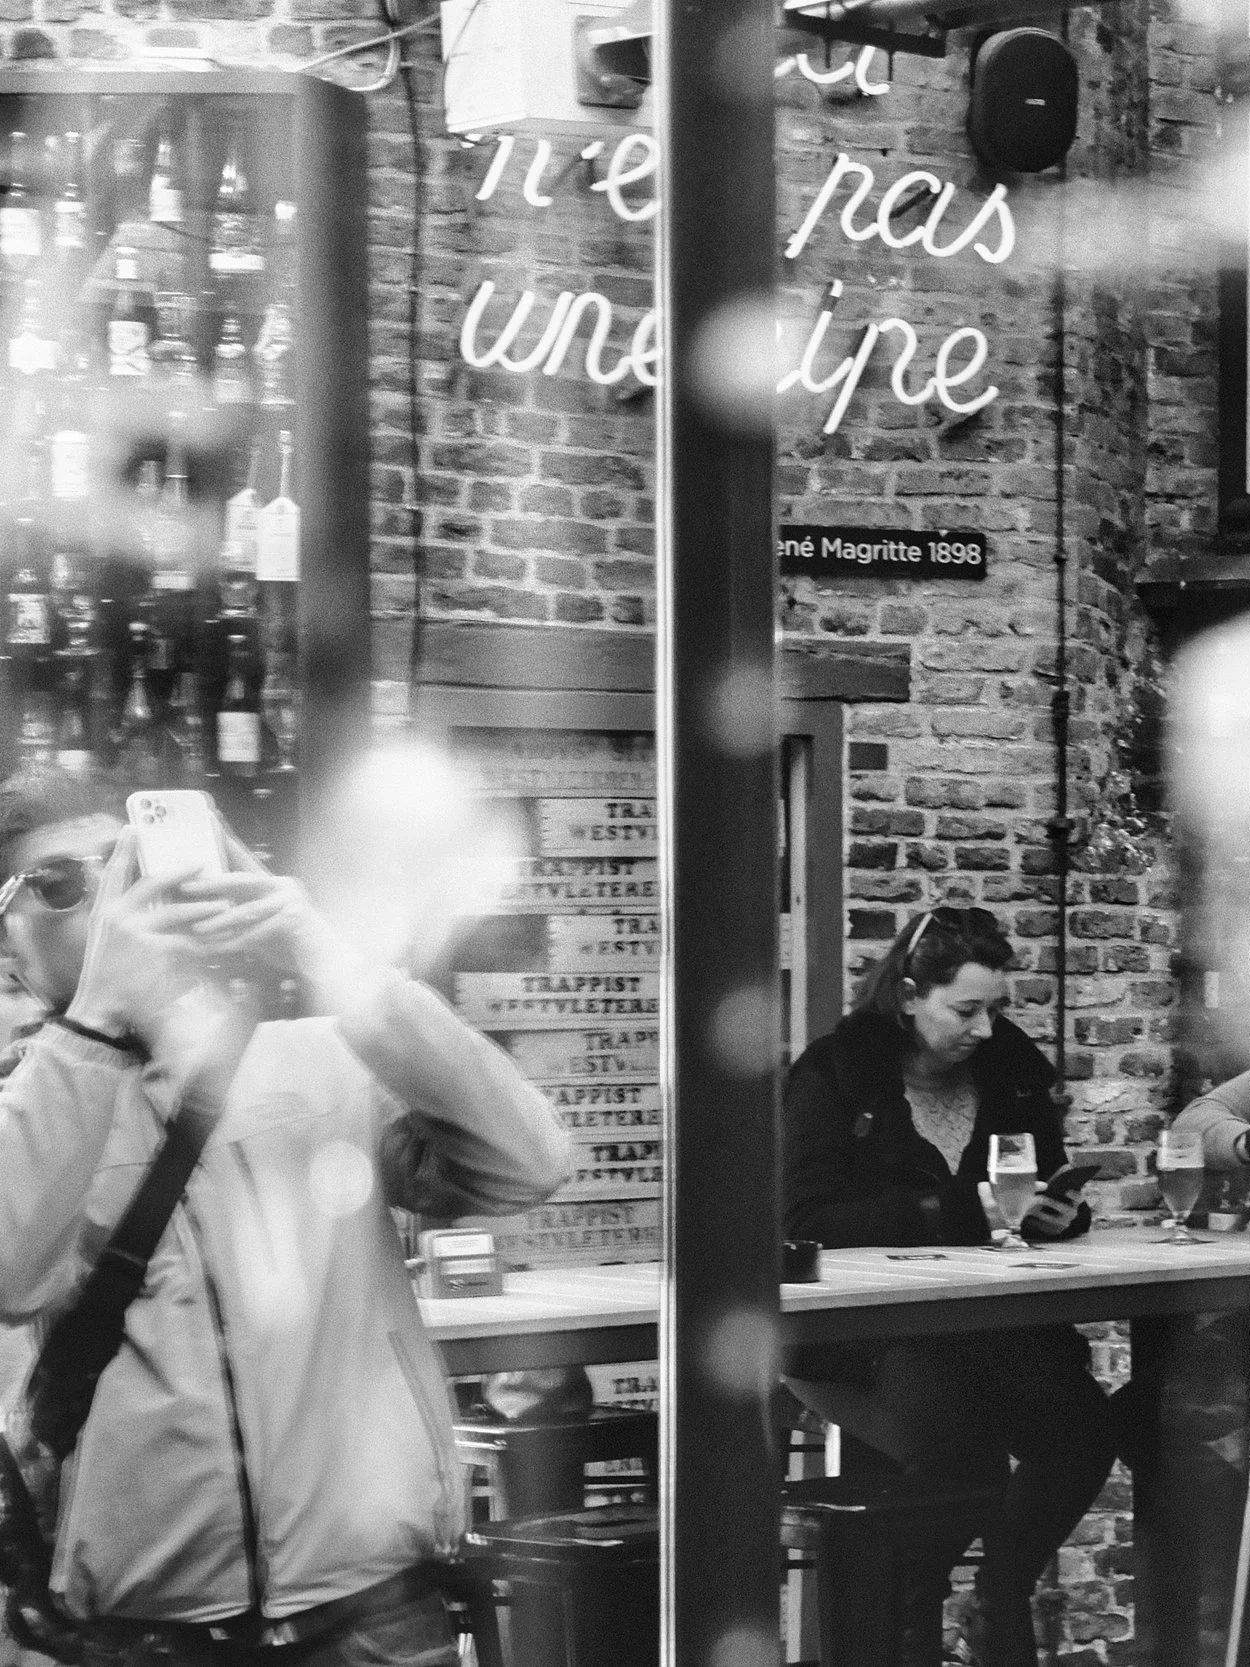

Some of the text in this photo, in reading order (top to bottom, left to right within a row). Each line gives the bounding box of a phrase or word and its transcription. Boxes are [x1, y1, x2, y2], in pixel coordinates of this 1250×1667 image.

[785, 153, 1016, 263] pas
[775, 279, 999, 434] ipe
[821, 537, 922, 564] Magritte
[928, 541, 982, 565] 1898
[523, 976, 640, 992] TRAPPIST
